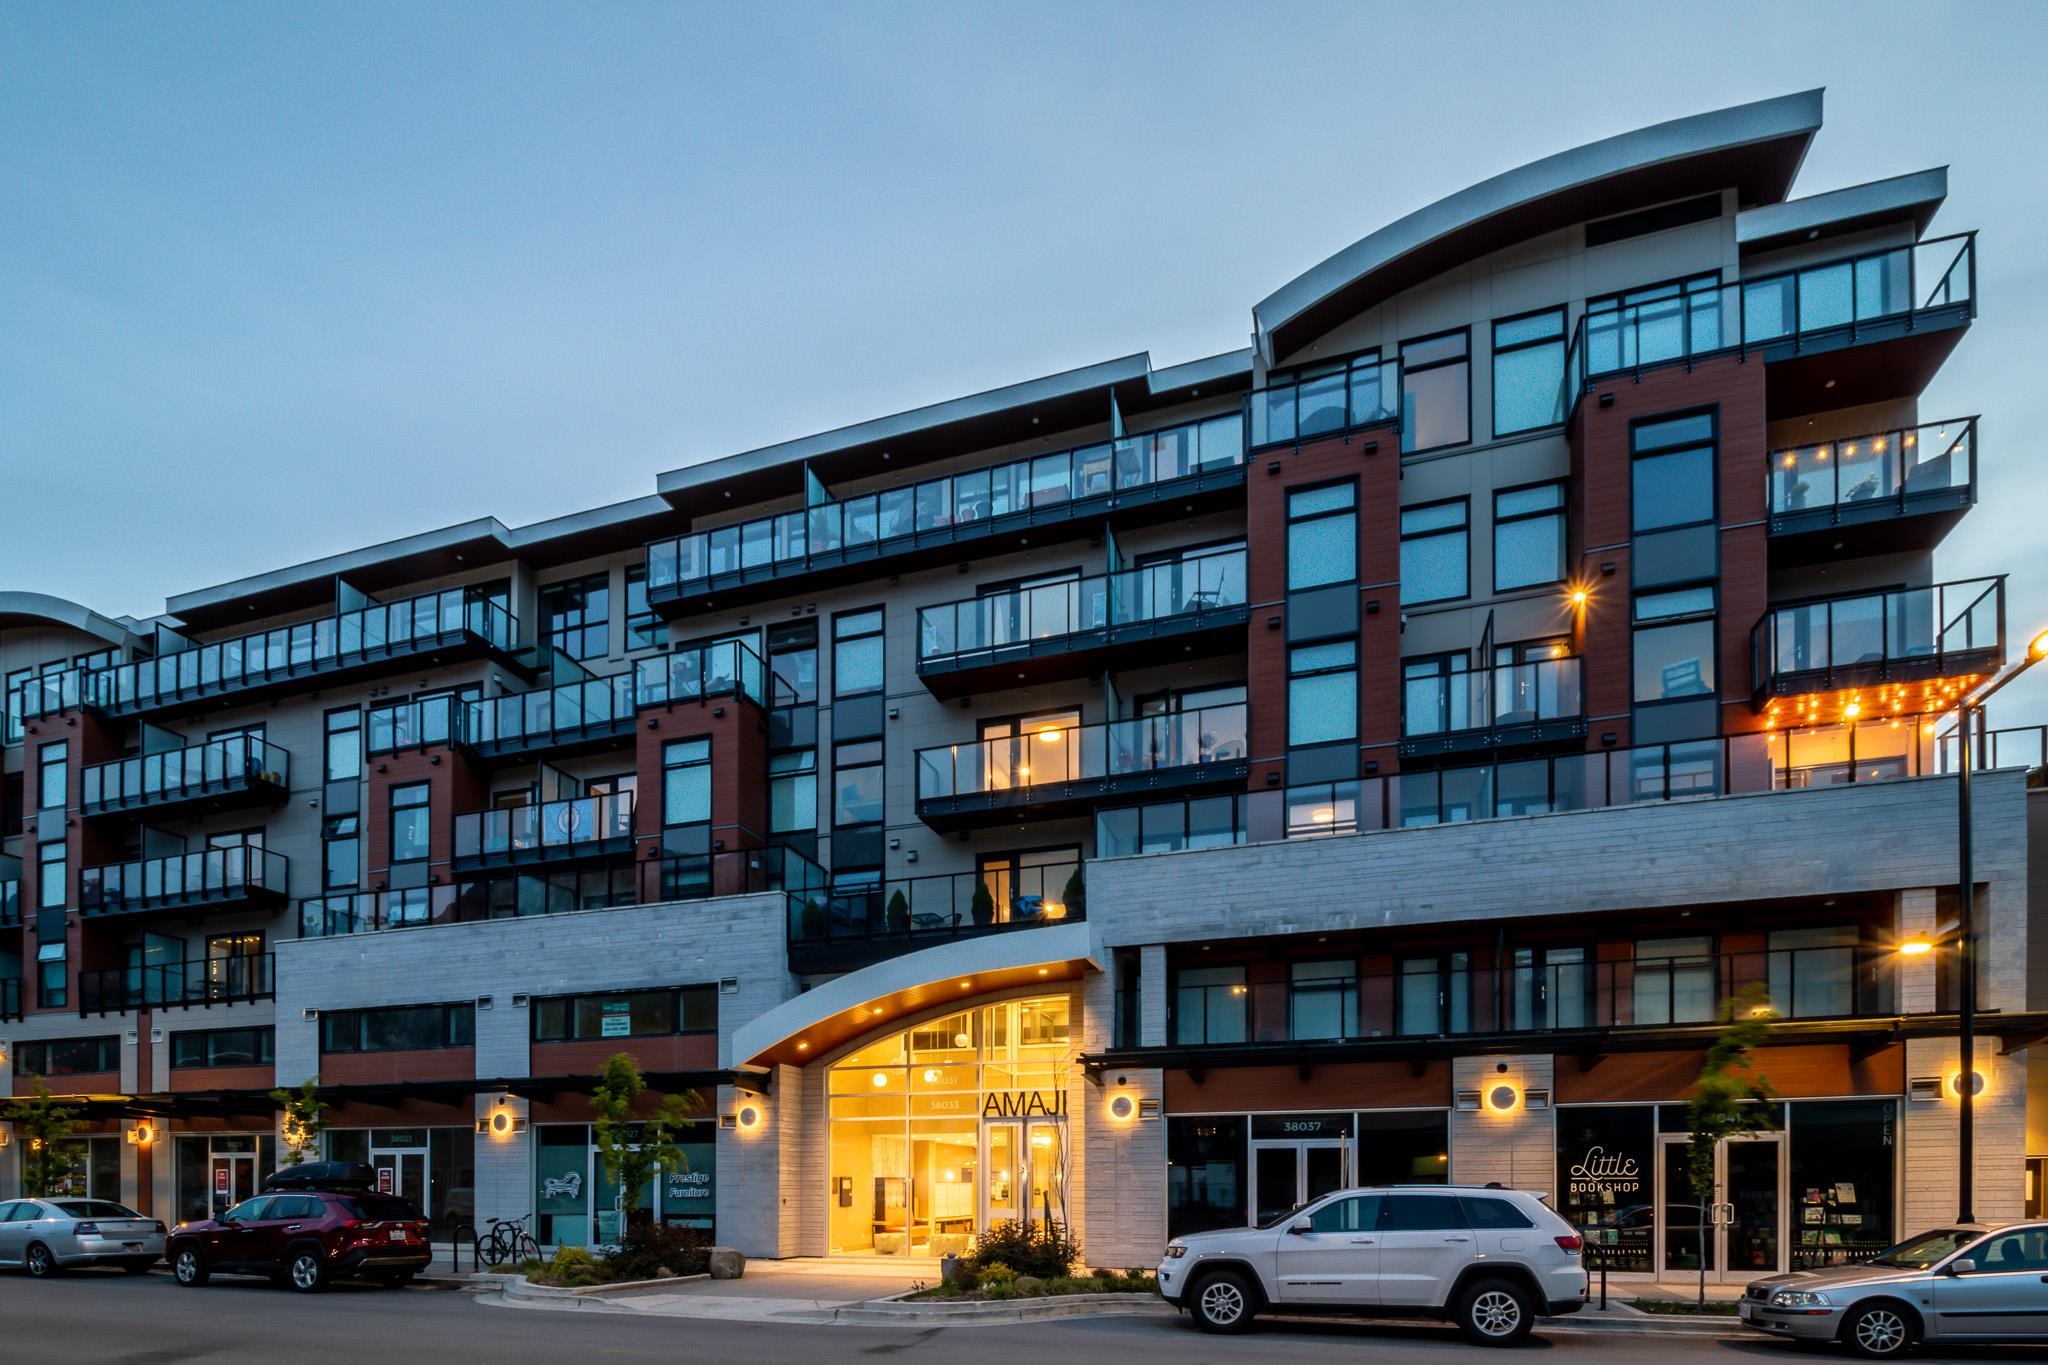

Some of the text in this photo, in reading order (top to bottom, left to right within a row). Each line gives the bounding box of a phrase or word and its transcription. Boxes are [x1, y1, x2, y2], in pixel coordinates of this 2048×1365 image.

[983, 1090, 1067, 1117] AMAJI
[1284, 1121, 1321, 1131] 38037
[1883, 1103, 1892, 1145] OPEN
[1570, 1146, 1639, 1180] Little
[669, 1172, 709, 1185] Prestige
[669, 1187, 709, 1197] Furniture
[1570, 1182, 1639, 1192] BOOKSHOP
